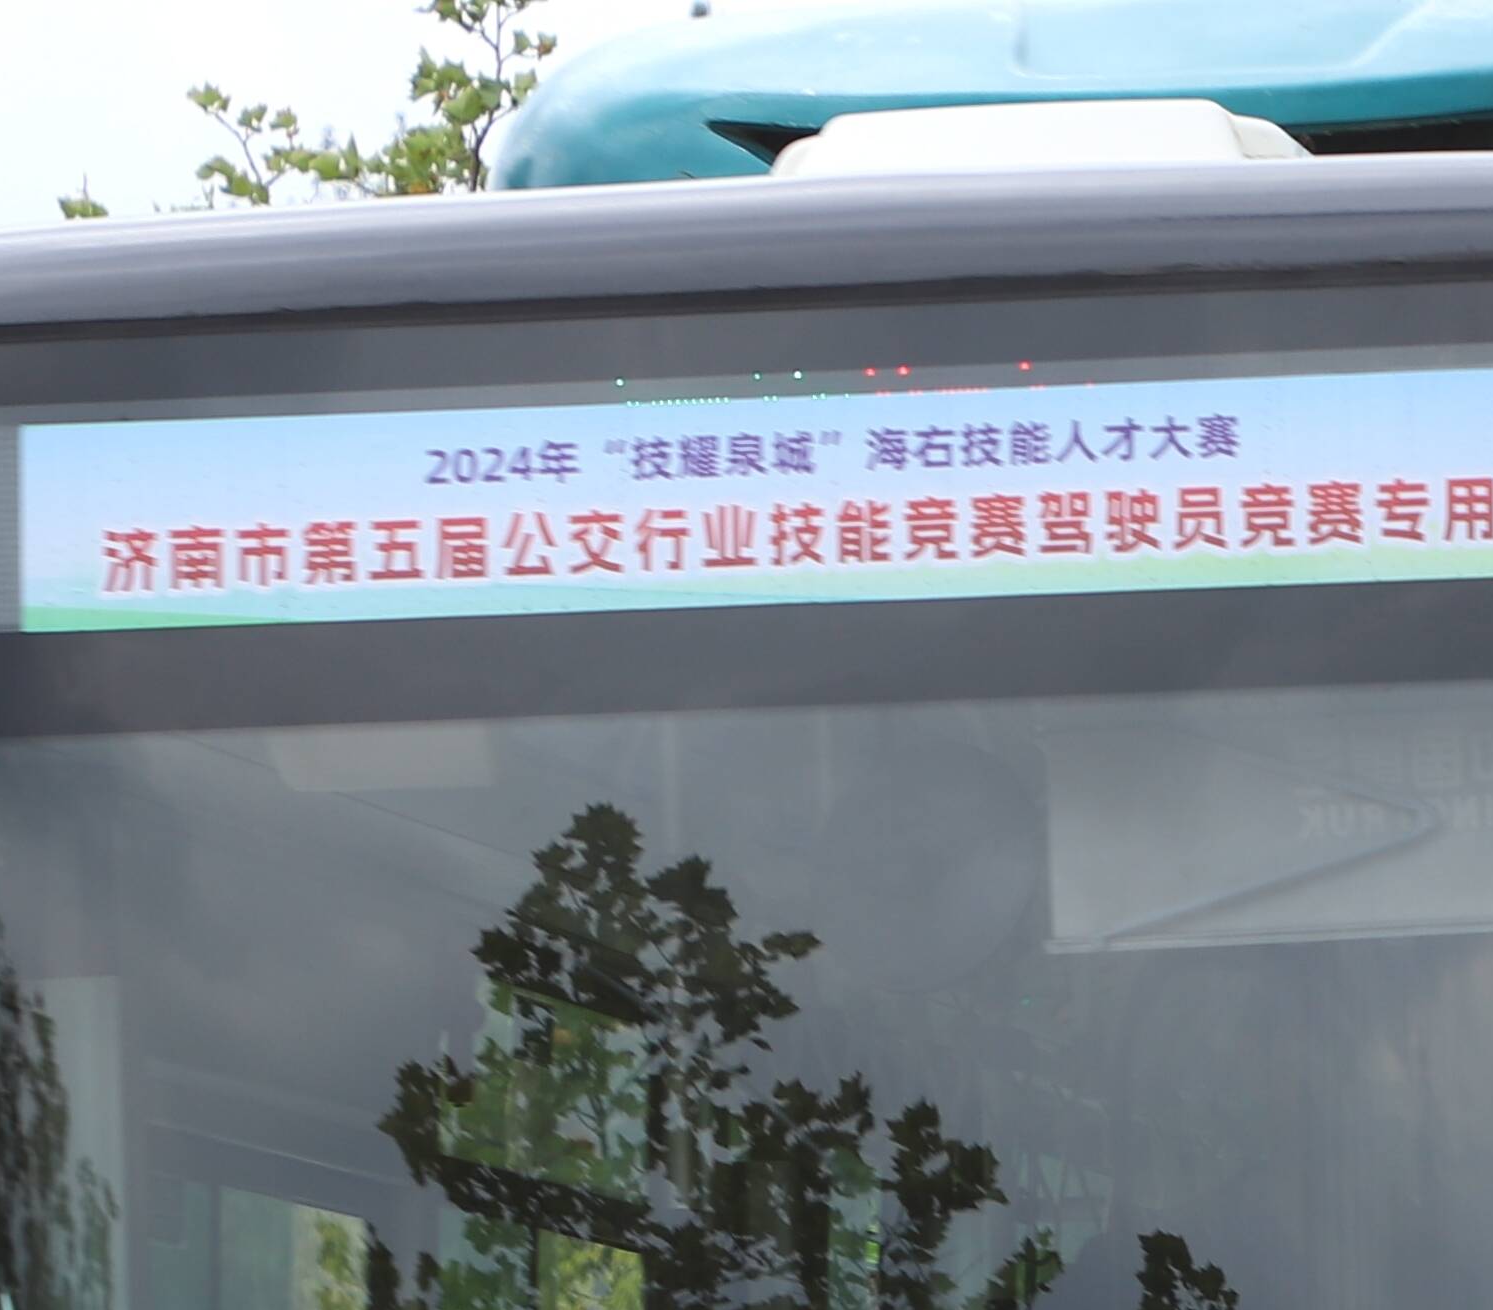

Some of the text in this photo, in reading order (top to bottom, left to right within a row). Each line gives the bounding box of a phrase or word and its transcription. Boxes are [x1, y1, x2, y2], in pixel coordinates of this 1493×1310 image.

[424, 440, 580, 485] 2024年
[865, 414, 1242, 471] 海右技能人才大赛
